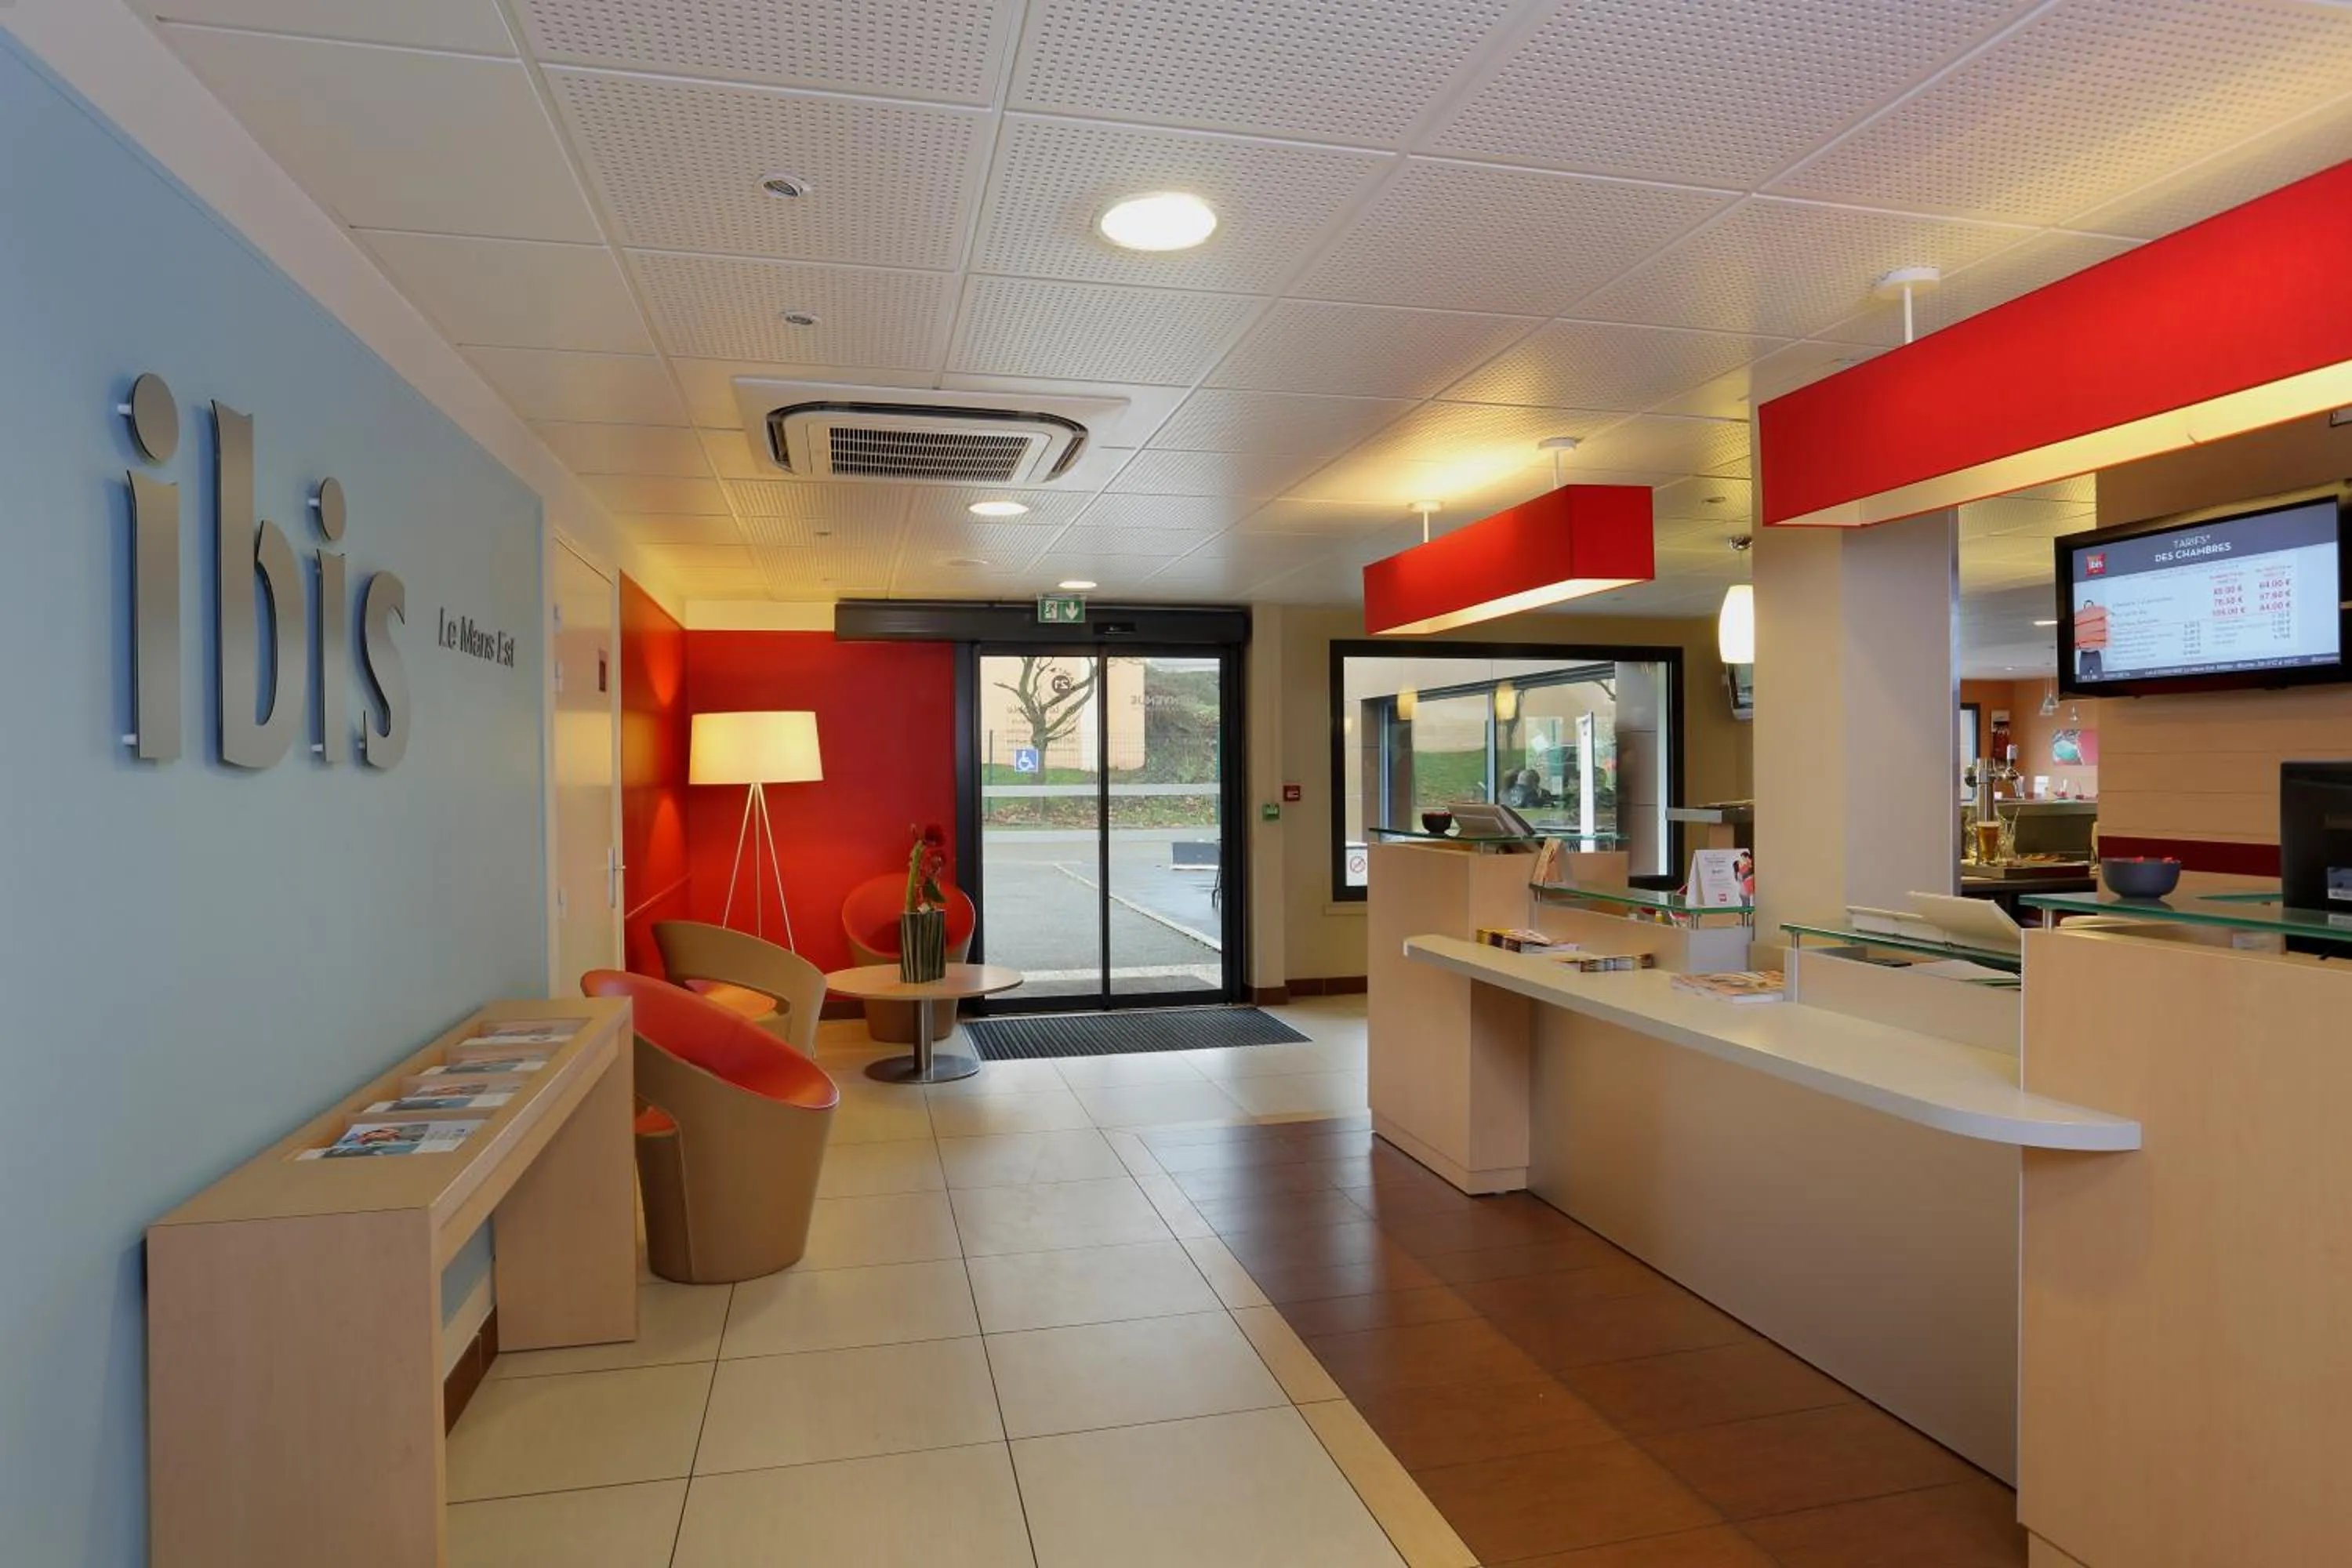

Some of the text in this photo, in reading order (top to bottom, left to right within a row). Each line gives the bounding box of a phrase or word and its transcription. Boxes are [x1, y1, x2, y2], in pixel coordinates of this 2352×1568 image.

[126, 372, 410, 769] ibis
[2154, 542, 2232, 563] DES CHAMBRES
[438, 605, 514, 668] Le Mans Est
